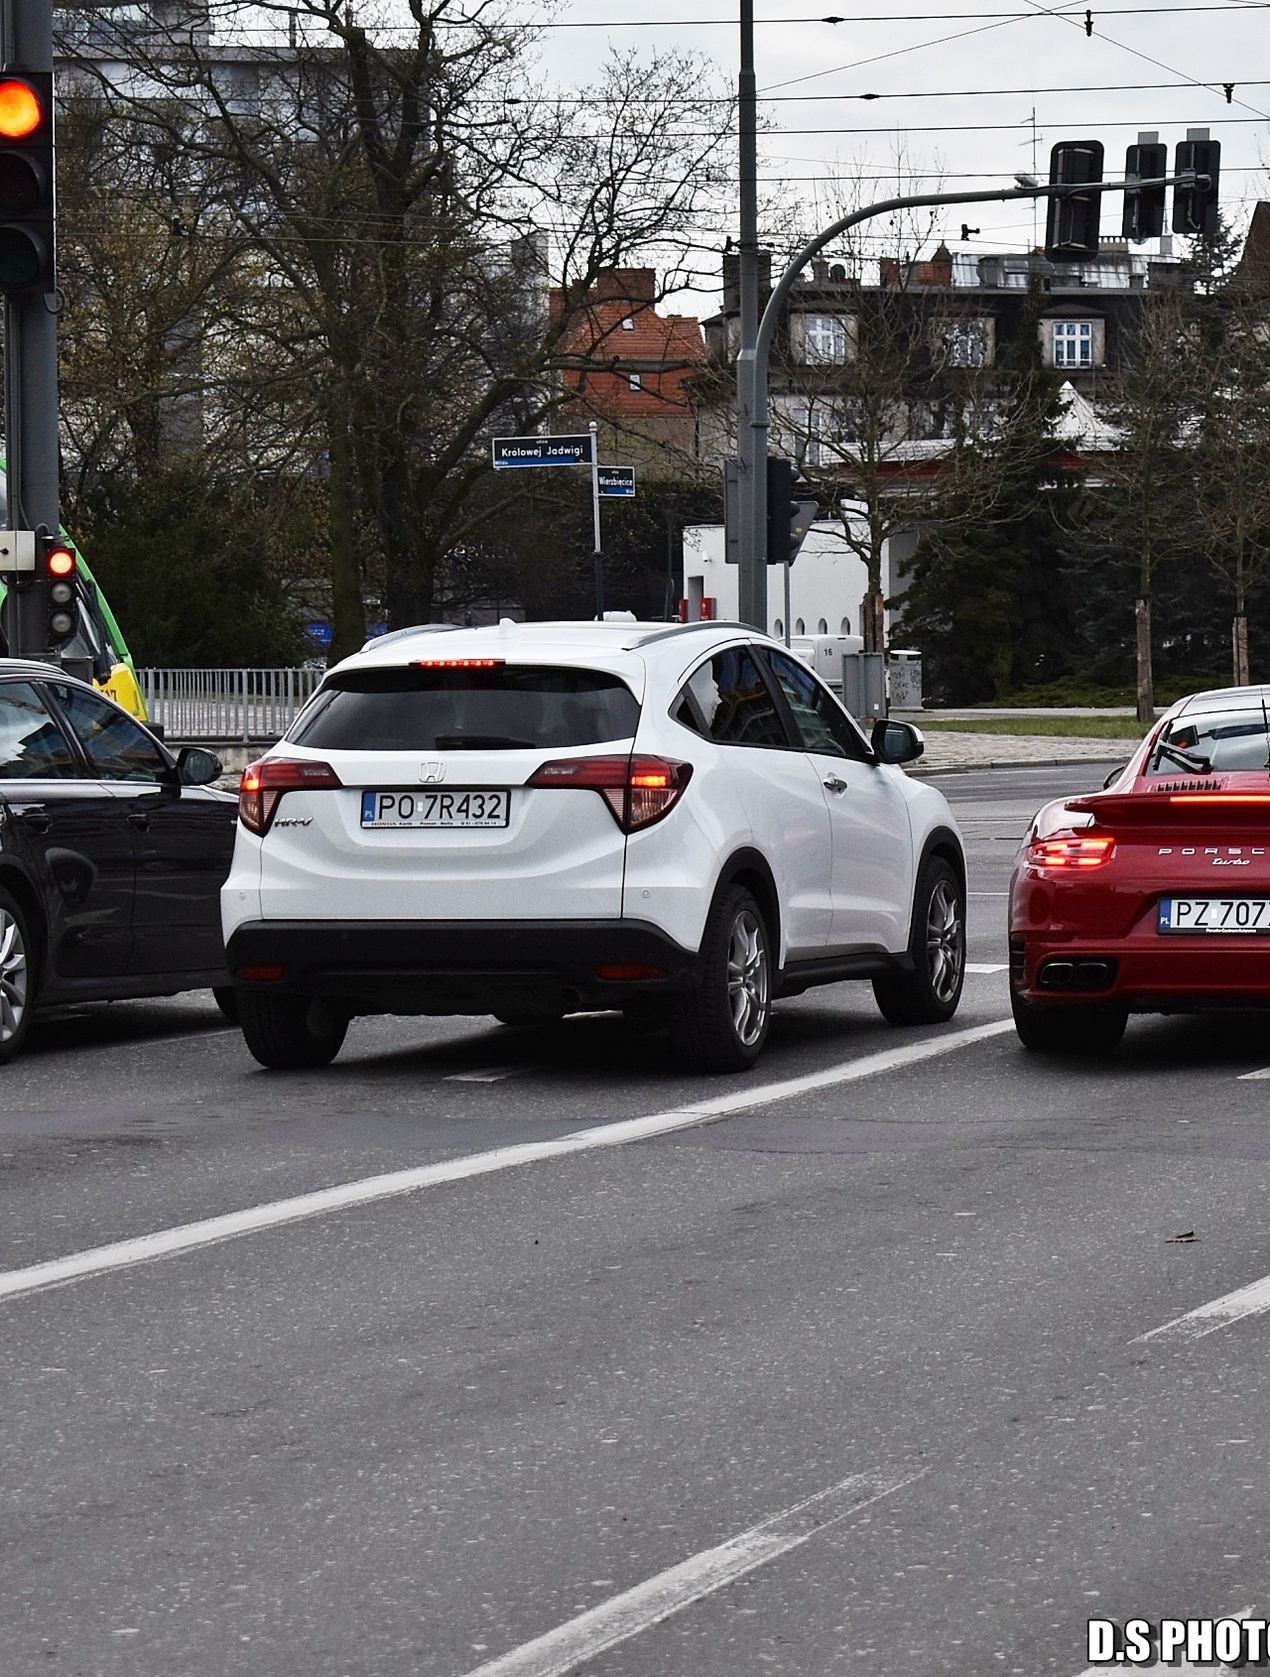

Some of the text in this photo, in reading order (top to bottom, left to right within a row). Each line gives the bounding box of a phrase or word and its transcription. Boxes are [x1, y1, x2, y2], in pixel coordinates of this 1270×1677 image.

[501, 445, 583, 457] Królowej Jadwigi
[824, 648, 833, 656] 16
[365, 794, 501, 820] PL PO 7R432
[1177, 901, 1209, 926] PZ
